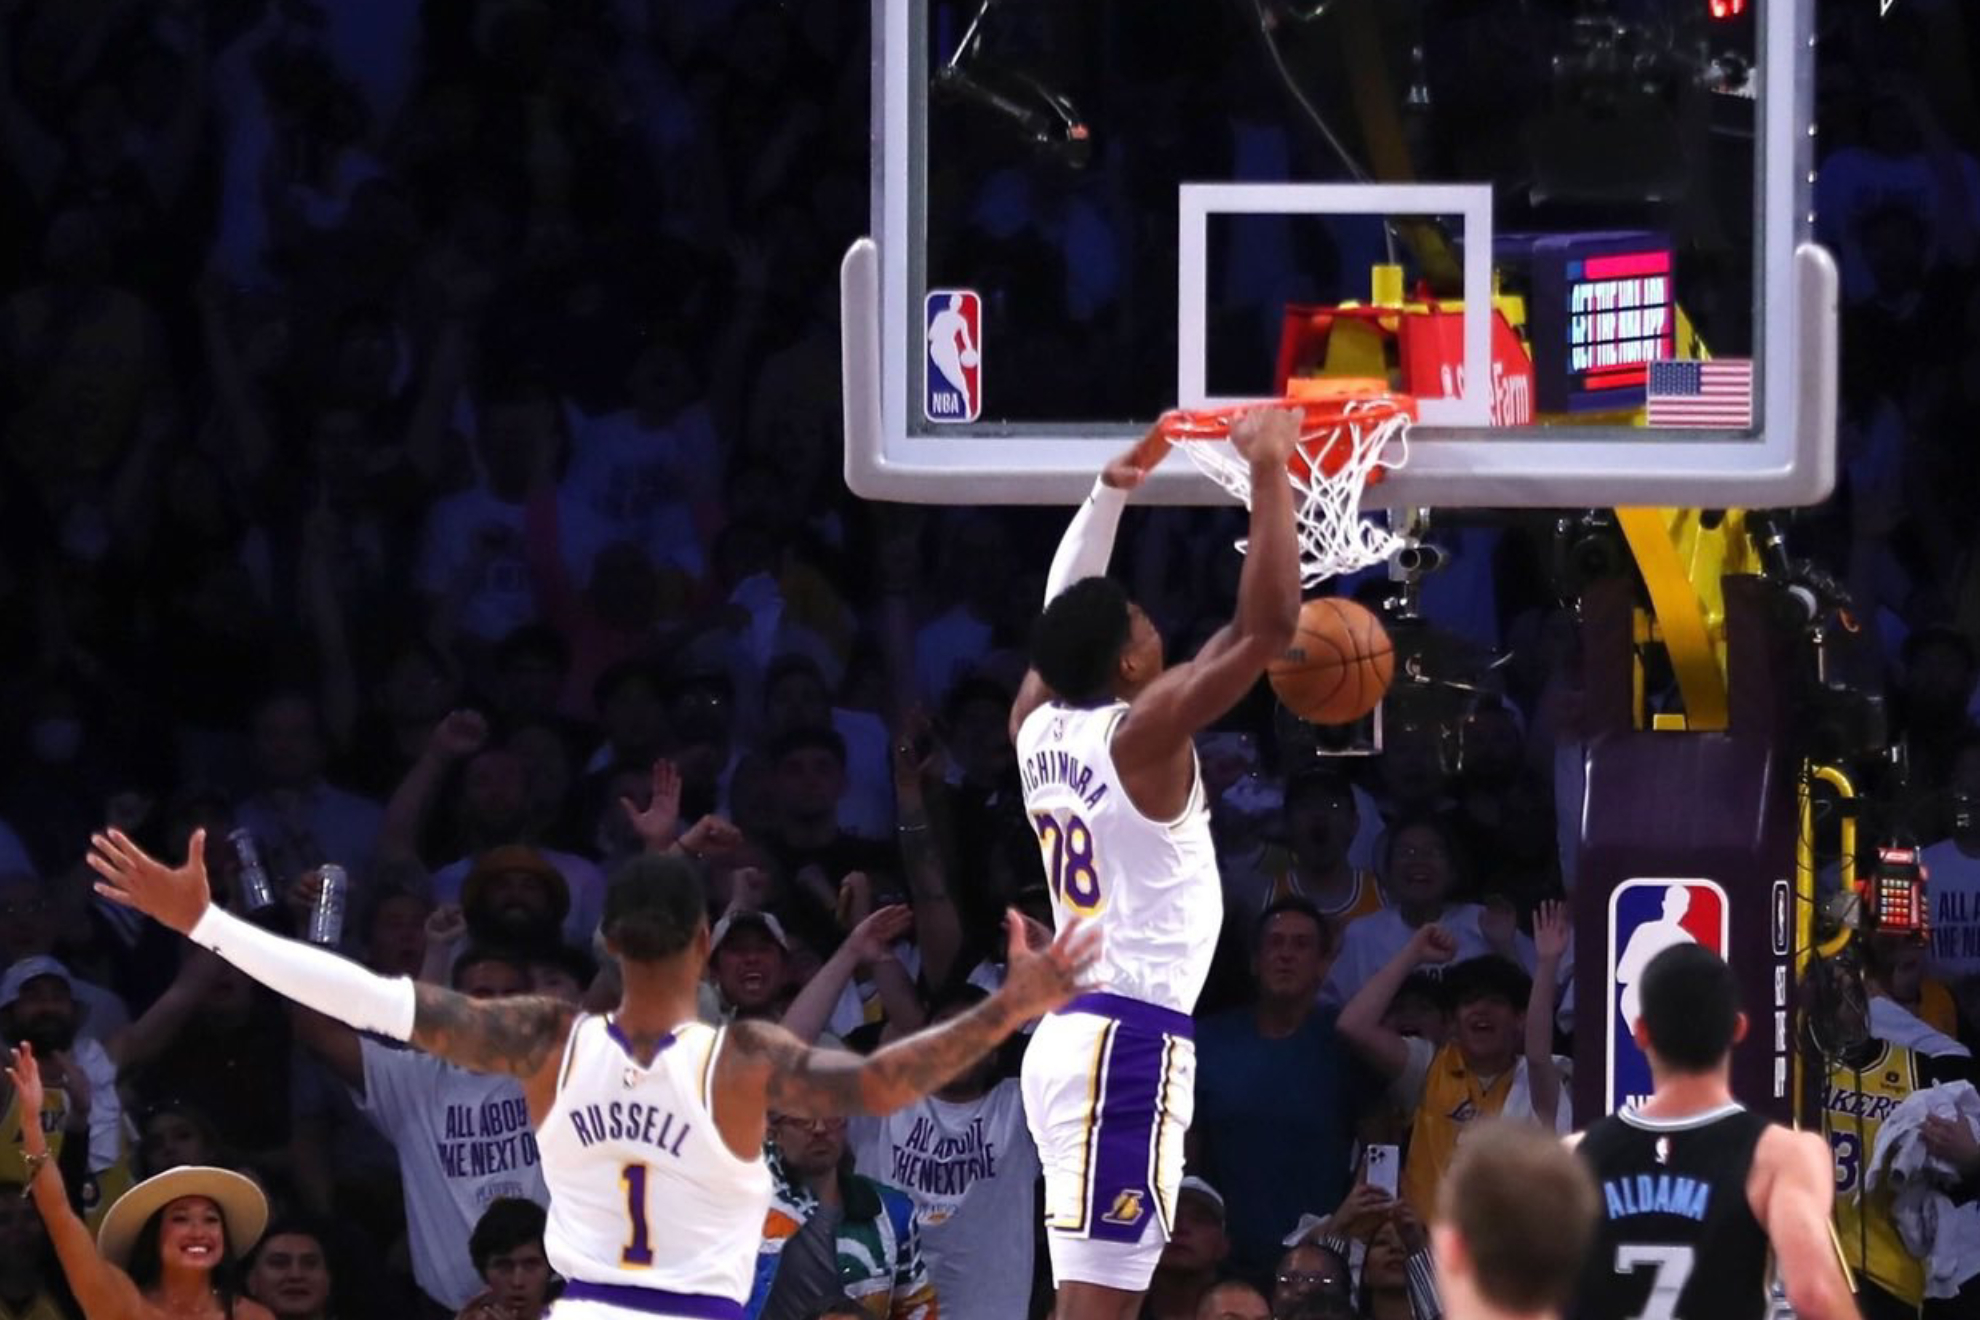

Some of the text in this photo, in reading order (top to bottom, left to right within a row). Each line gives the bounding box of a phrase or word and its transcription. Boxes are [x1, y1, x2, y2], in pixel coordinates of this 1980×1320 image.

[932, 392, 959, 414] NBA
[1492, 362, 1530, 427] Farm
[1939, 891, 1967, 922] ALL
[446, 1098, 528, 1139] ALL ABOU
[570, 1101, 691, 1158] RUSSELL
[906, 1117, 934, 1151] ALL
[470, 1137, 518, 1177] NEXT
[521, 1132, 540, 1166] O
[892, 1145, 921, 1187] THE
[918, 1158, 968, 1195] NEXT
[621, 1162, 654, 1269] 1
[1604, 1174, 1709, 1220] ALDAMA
[1615, 1244, 1694, 1320] 7
